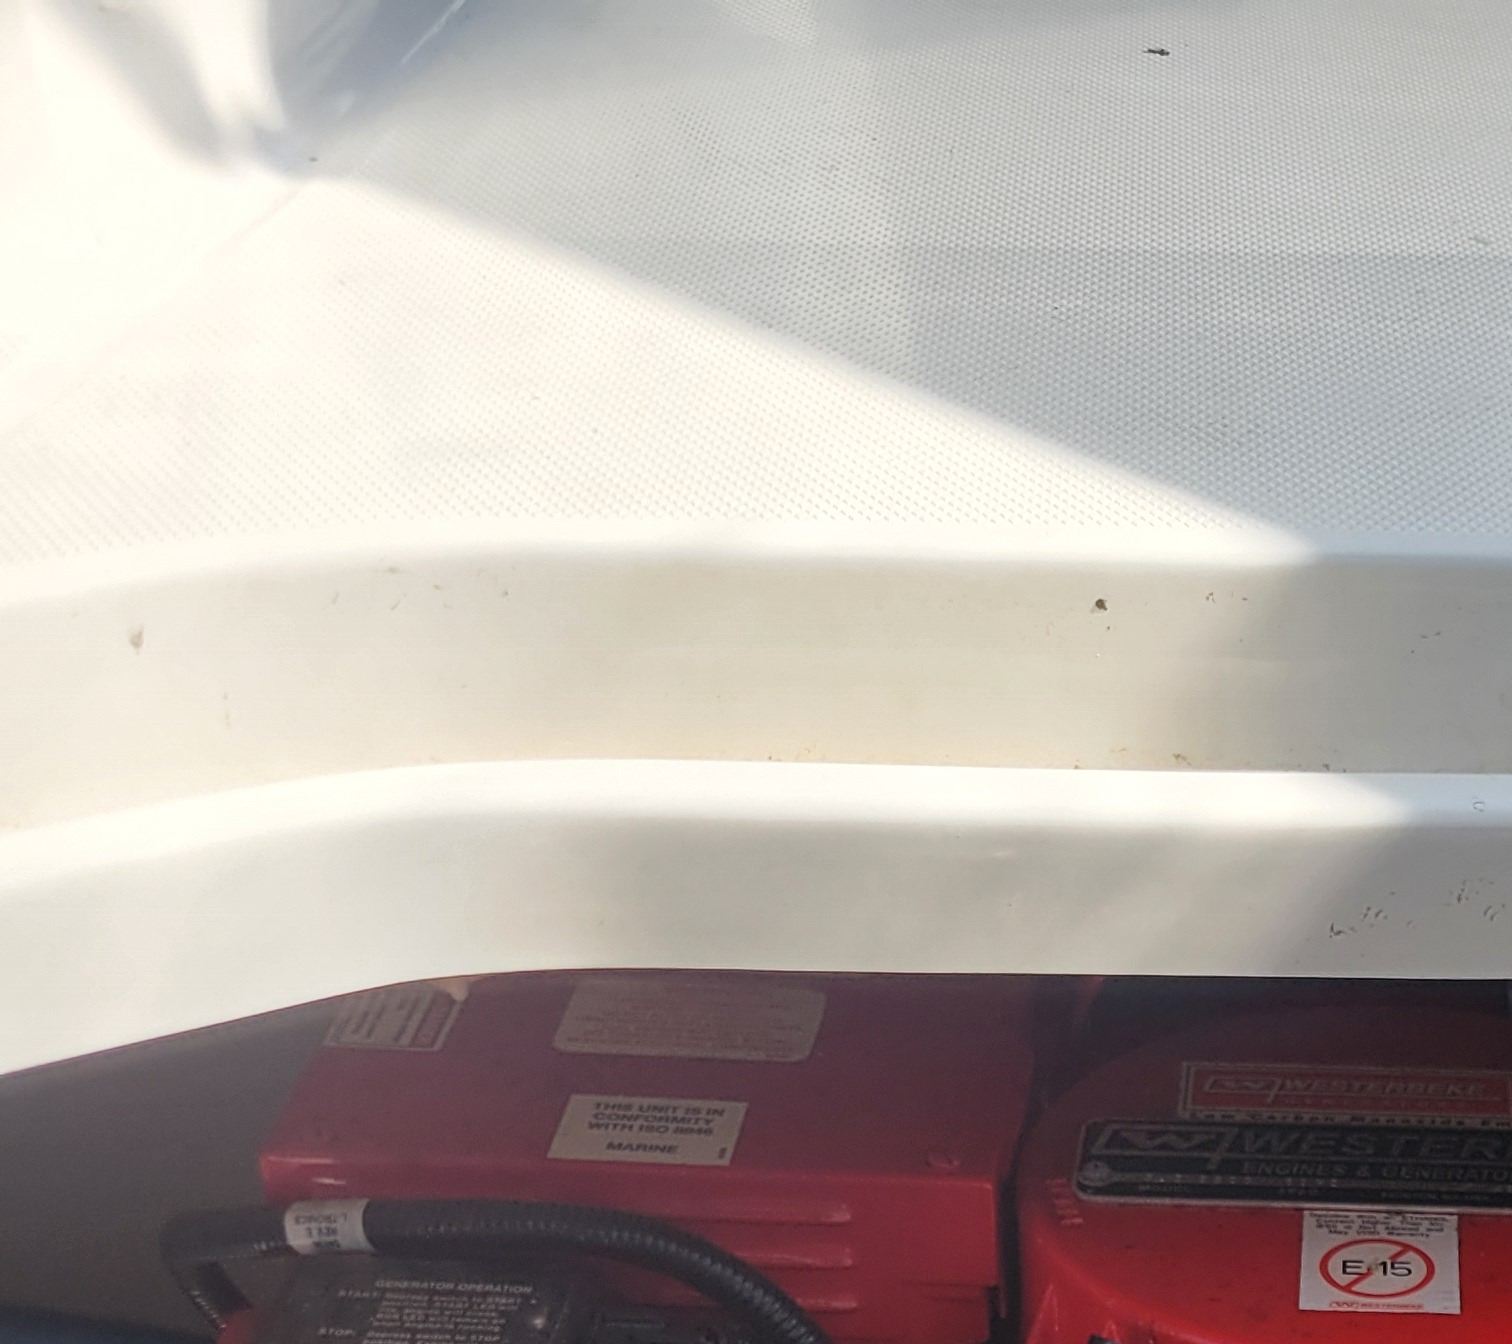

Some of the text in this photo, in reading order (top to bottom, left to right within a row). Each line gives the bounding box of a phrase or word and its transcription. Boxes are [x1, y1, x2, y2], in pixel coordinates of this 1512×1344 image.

[595, 1102, 725, 1117] THIS UNIT IS IN
[592, 1112, 715, 1126] CONFORMITY
[587, 1121, 670, 1134] WITH ISO
[605, 1141, 680, 1155] MARINE
[1242, 1162, 1351, 1178] ENGINES
[1357, 1164, 1373, 1179] &
[374, 1279, 534, 1294] GENERATOR OPERATION
